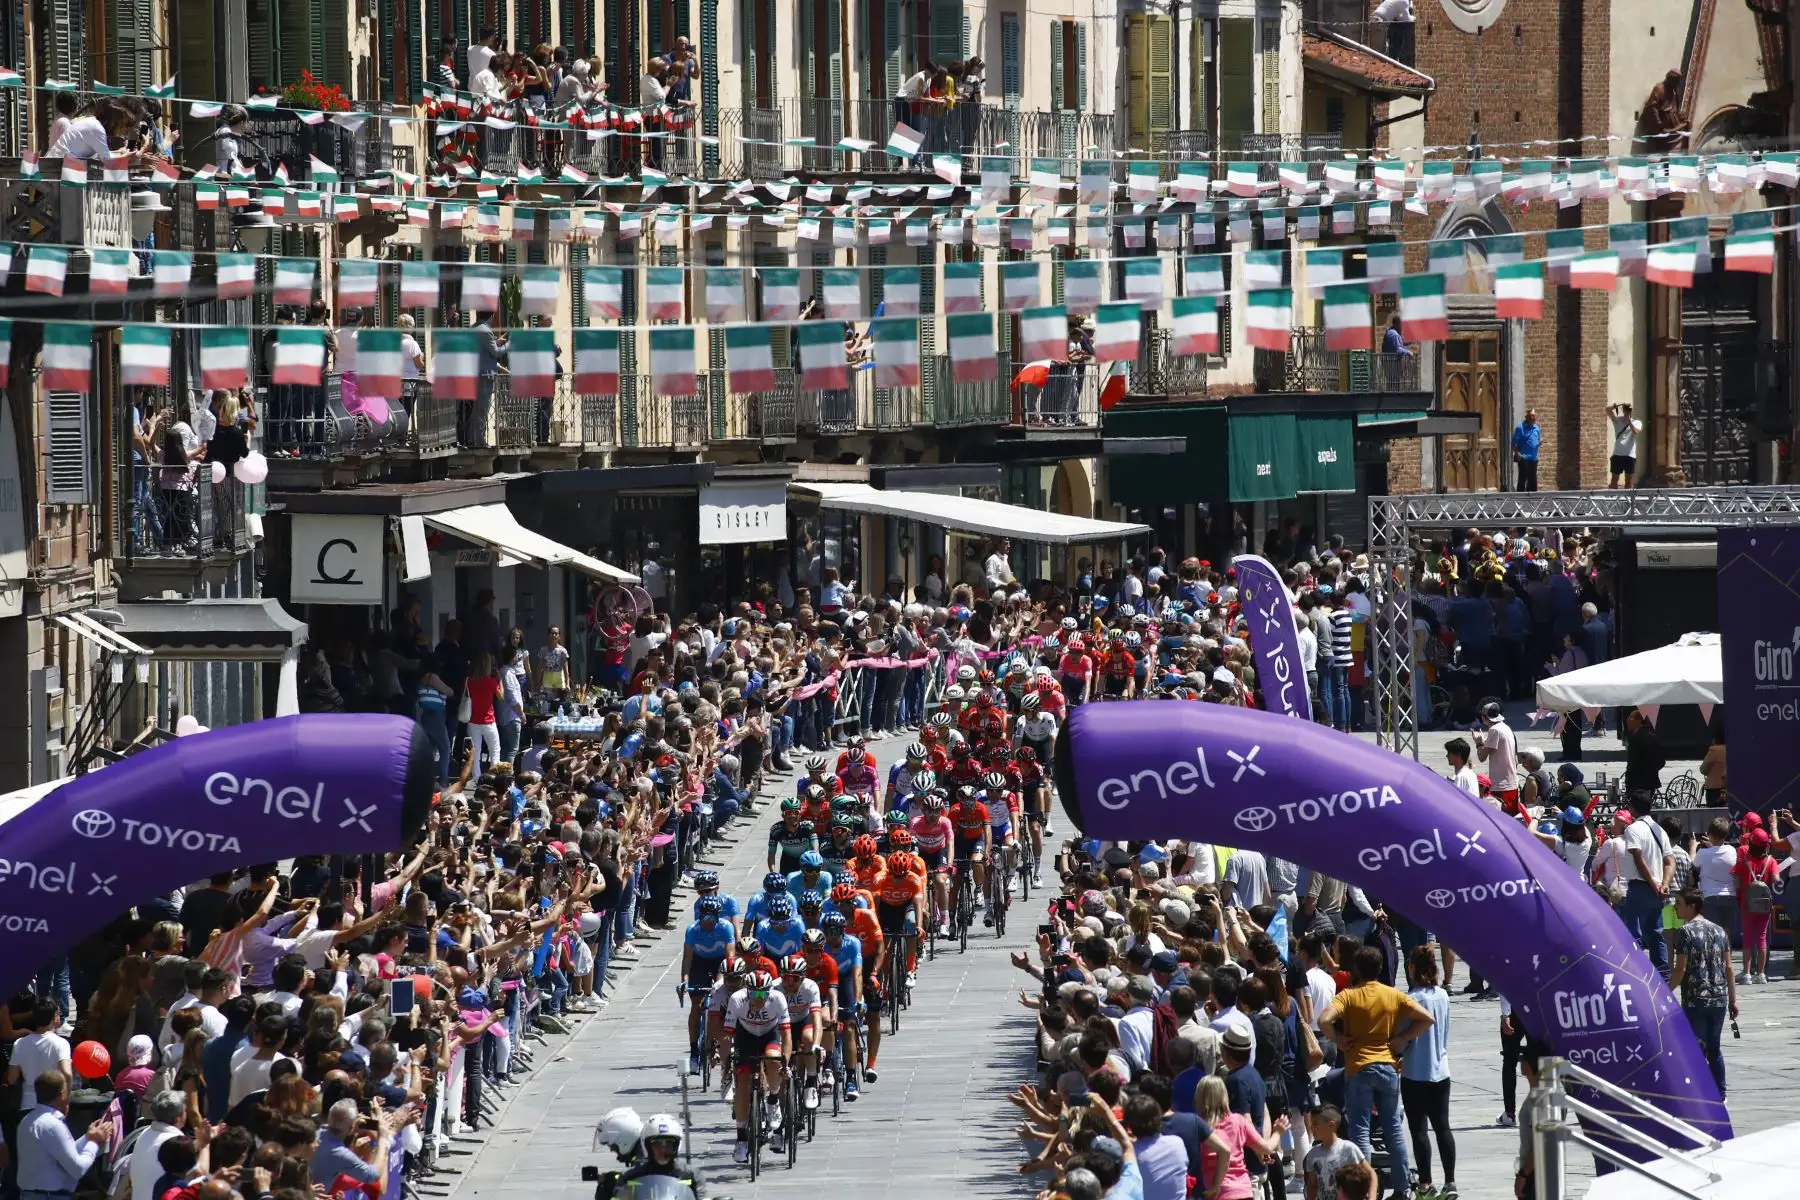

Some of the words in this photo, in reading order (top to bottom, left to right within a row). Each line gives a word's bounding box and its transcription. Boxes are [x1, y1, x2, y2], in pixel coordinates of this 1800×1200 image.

[716, 511, 769, 529] SISLEY
[1757, 698, 1800, 721] enel
[1097, 746, 1216, 810] enel
[204, 771, 325, 824] enel
[1279, 785, 1403, 824] TOYOTA
[121, 818, 242, 854] TOYOTA
[1358, 828, 1447, 871] enel
[1457, 878, 1546, 903] TOYOTA
[1568, 1041, 1619, 1065] enel
